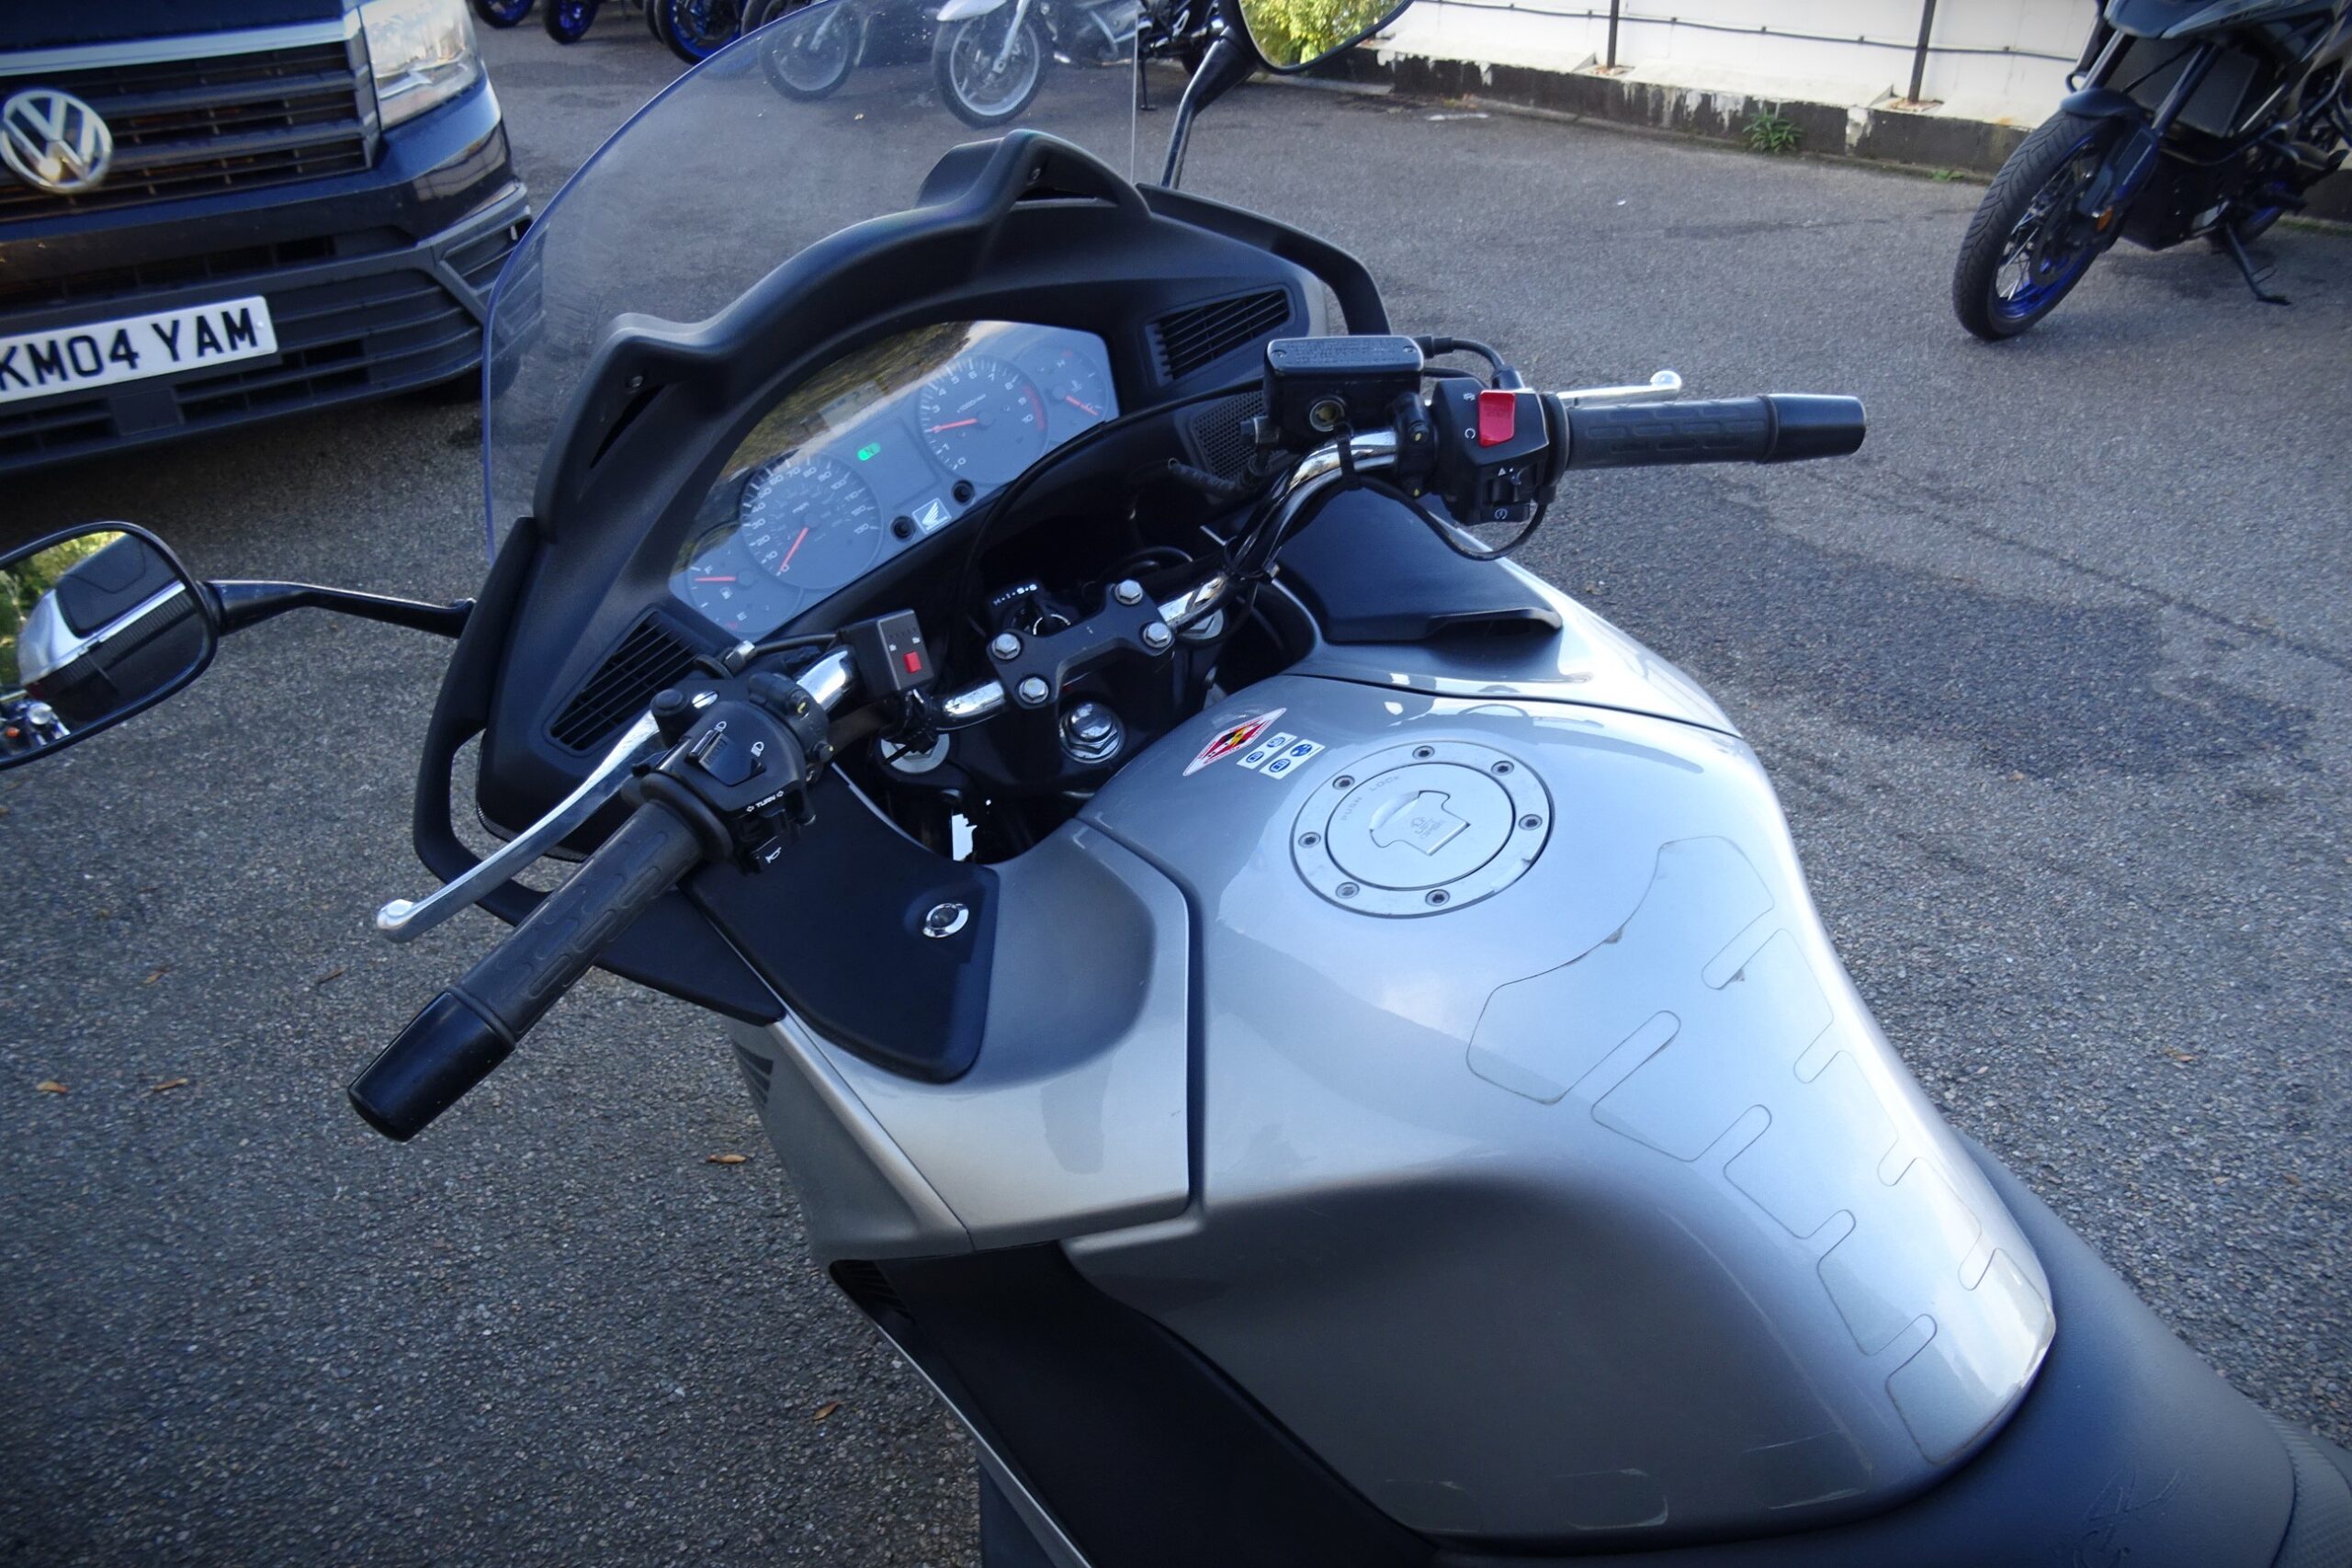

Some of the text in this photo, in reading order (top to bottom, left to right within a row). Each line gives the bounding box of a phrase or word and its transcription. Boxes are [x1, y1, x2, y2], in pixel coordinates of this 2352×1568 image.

[0, 307, 258, 391] KM04 YAM
[755, 794, 776, 808] TURN
